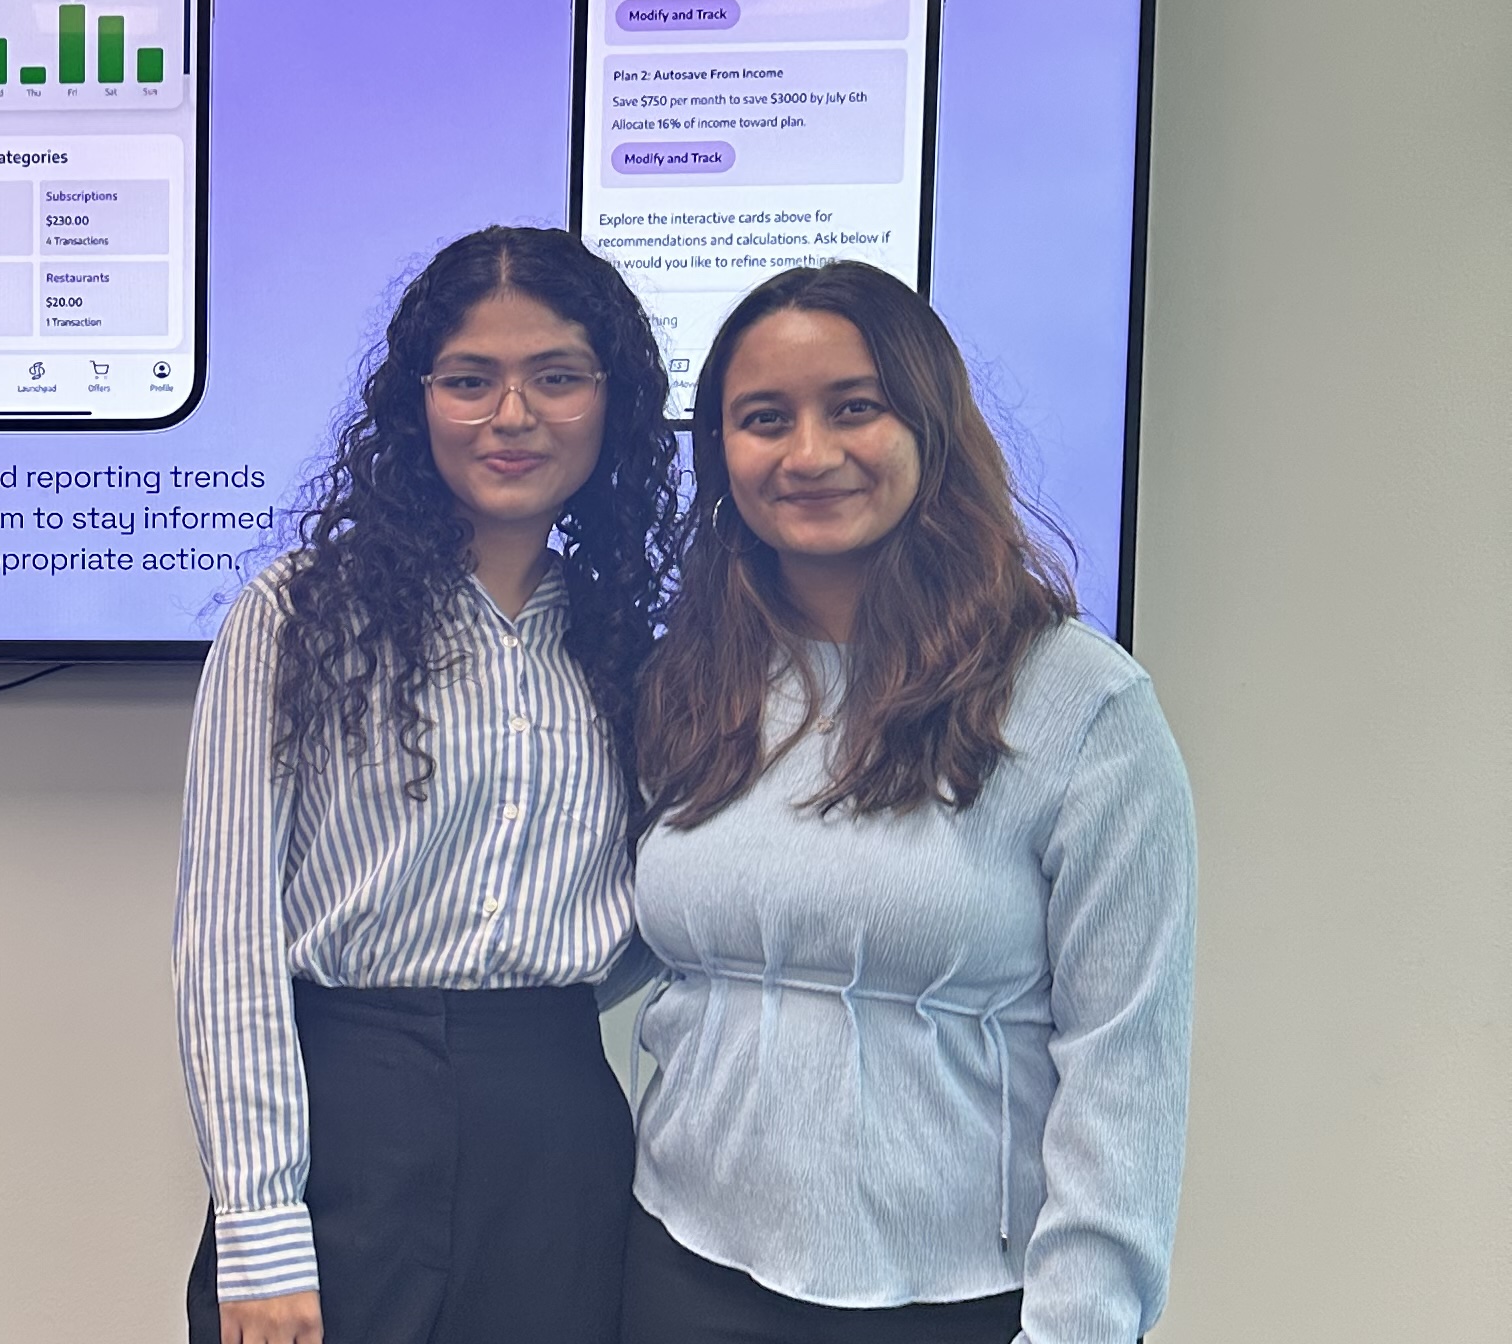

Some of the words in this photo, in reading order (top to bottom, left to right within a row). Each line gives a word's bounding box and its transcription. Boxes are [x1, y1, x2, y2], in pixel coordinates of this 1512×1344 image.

[629, 8, 669, 23] Modify
[671, 8, 693, 20] and
[696, 7, 726, 20] Track
[613, 69, 638, 81] Plan
[653, 69, 707, 80] Autosave
[710, 68, 739, 79] From
[742, 68, 783, 78] Income
[45, 190, 117, 203] Subscriptions
[45, 214, 89, 227] $230.00
[599, 212, 644, 228] Explore
[647, 212, 667, 224] the
[670, 212, 735, 224] interactive
[738, 210, 771, 223] cards
[773, 210, 811, 223] above
[815, 209, 832, 222] for
[53, 236, 108, 245] Transactions
[46, 272, 109, 283] Restaurants
[45, 296, 82, 308] $20.00
[26, 464, 160, 494] reporting
[168, 463, 265, 488] trends
[32, 506, 64, 530] to
[72, 506, 135, 535] stay
[144, 505, 274, 530] informed
[141, 546, 242, 571] action.
